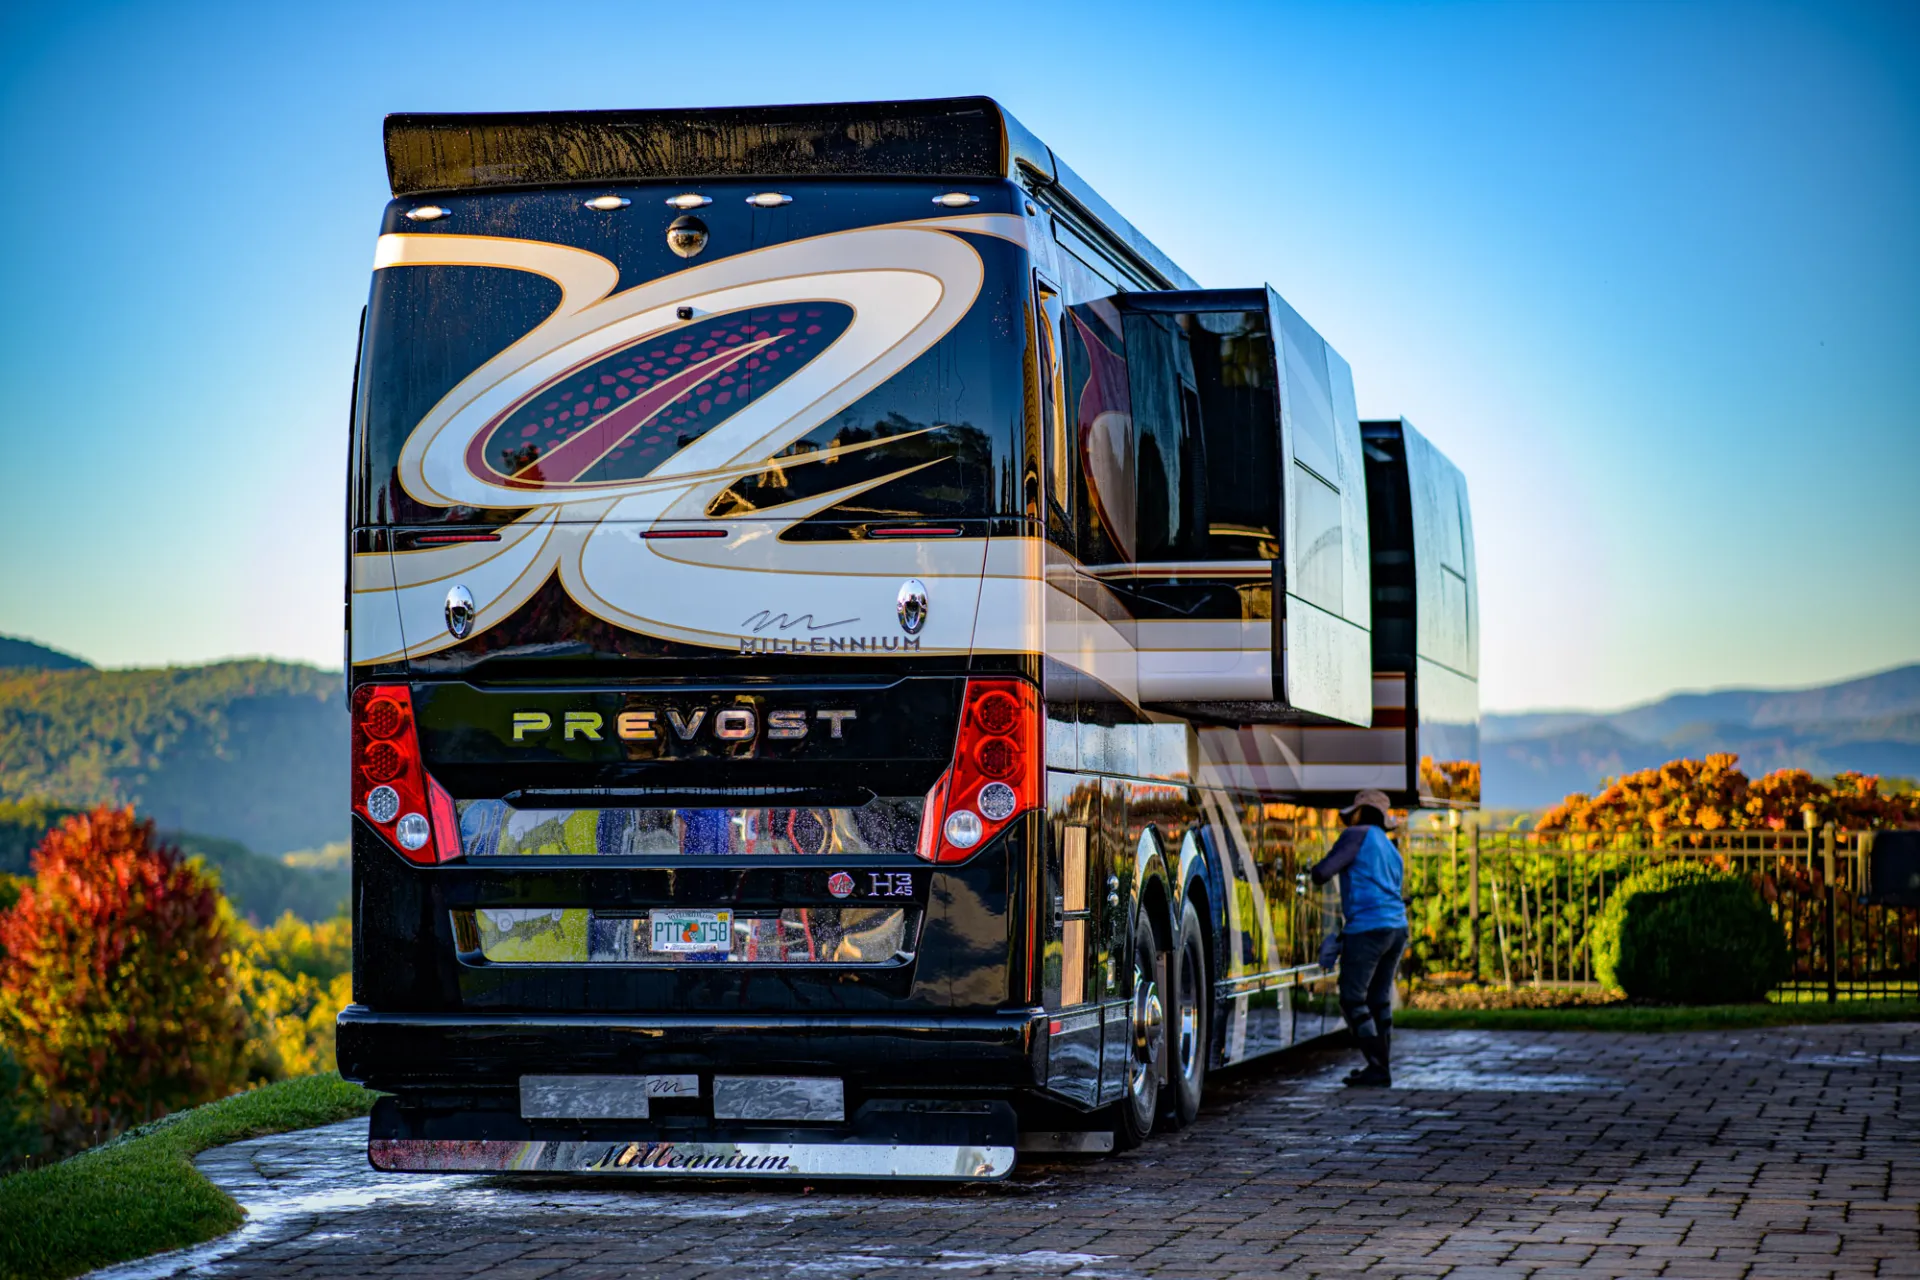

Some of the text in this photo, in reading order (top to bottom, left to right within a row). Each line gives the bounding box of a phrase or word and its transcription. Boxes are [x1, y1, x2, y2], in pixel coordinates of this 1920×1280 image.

[740, 636, 921, 655] MILLENNIUM
[512, 707, 857, 741] PREVOST
[655, 922, 727, 942] PTT T58
[586, 1145, 790, 1170] Millennium
